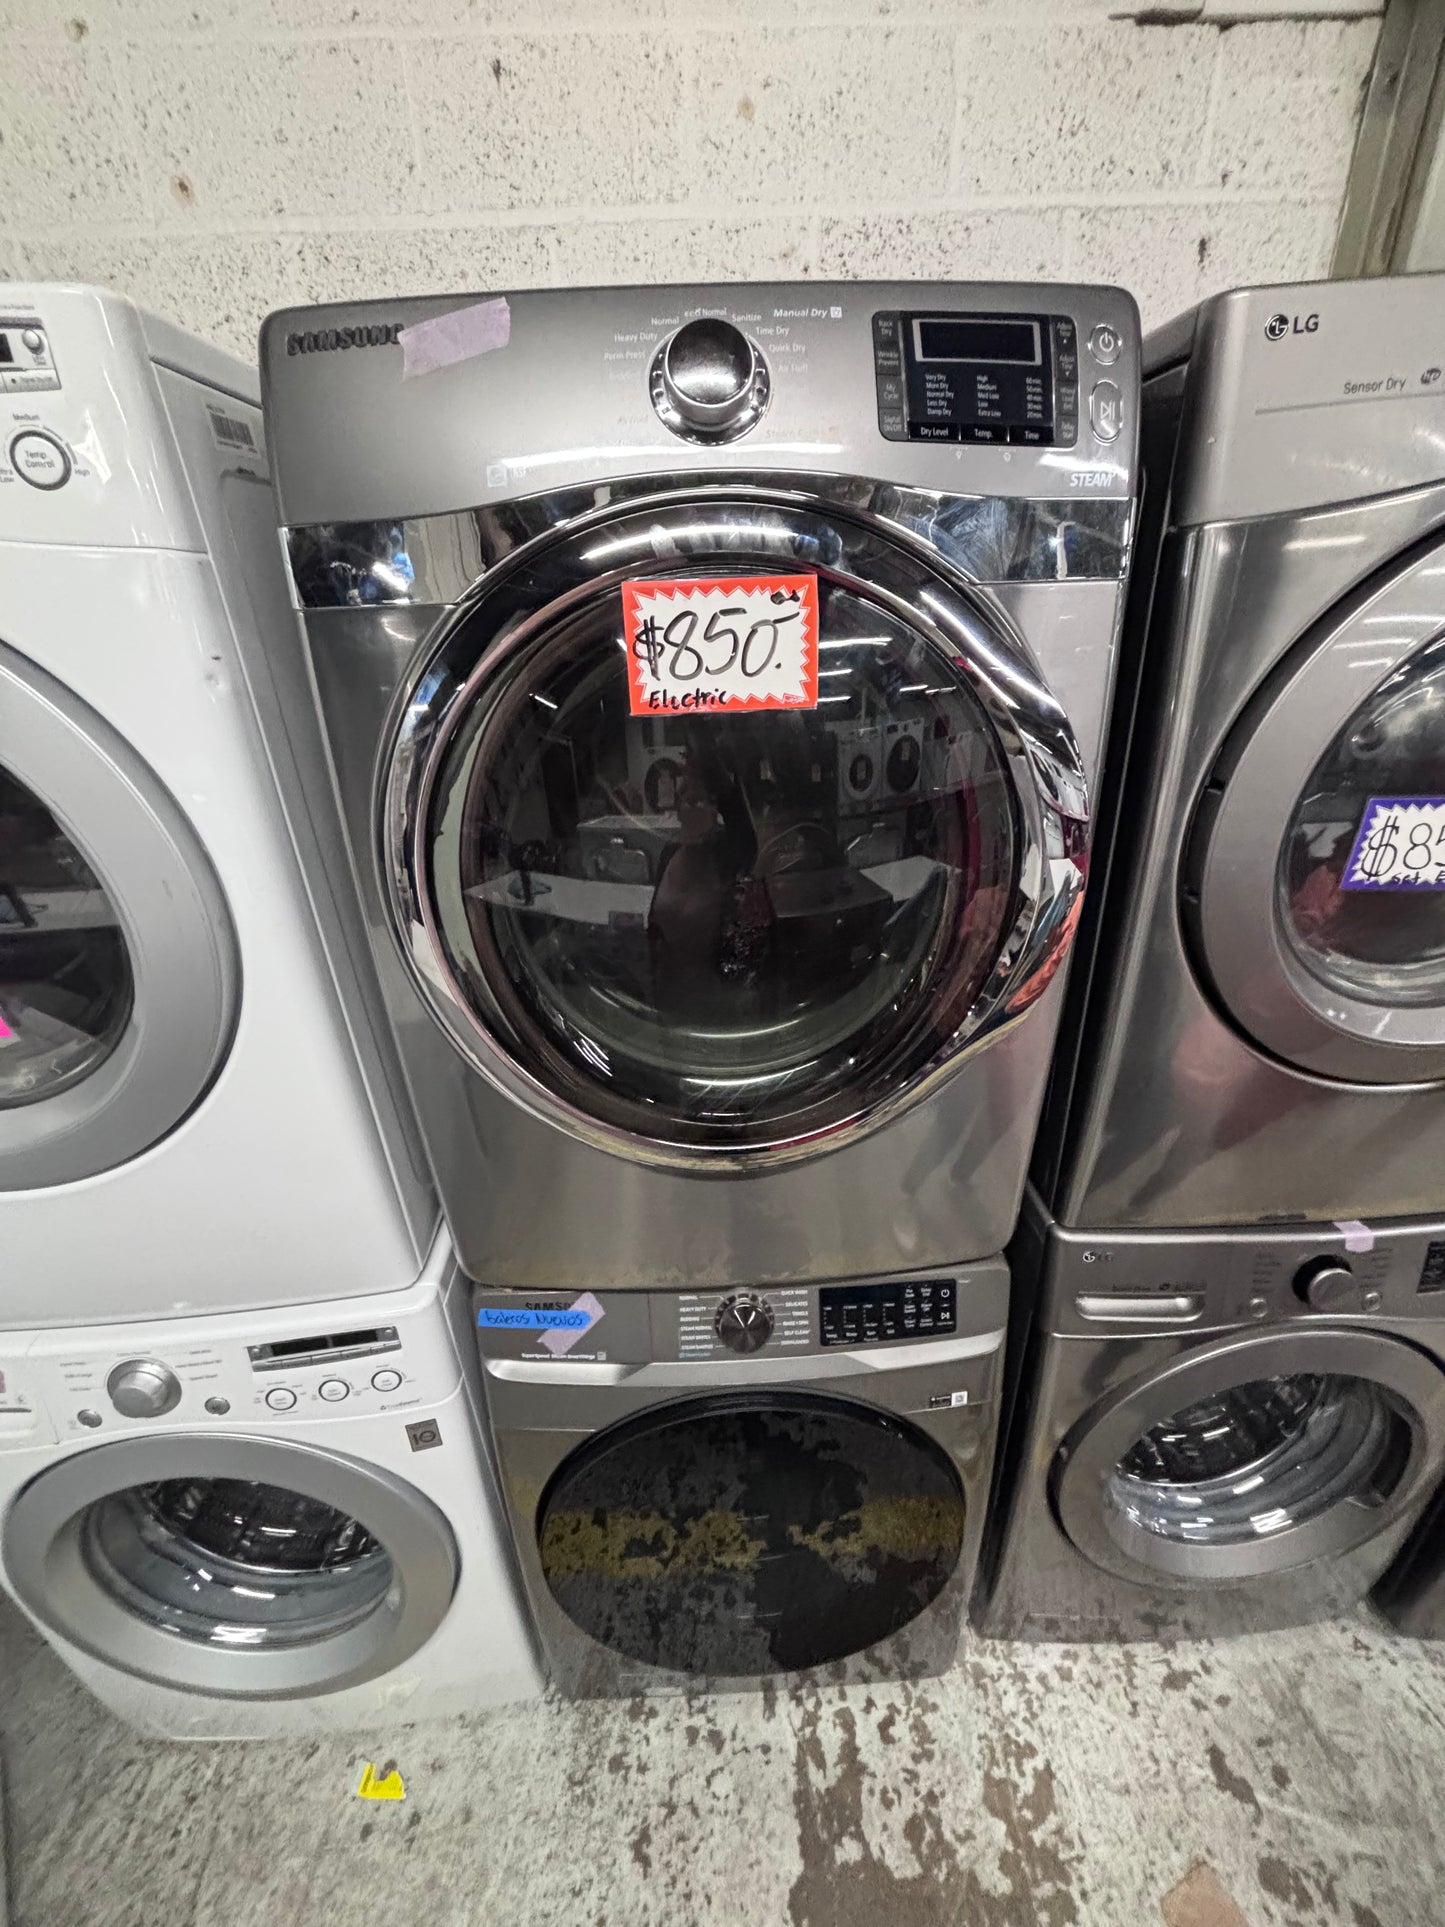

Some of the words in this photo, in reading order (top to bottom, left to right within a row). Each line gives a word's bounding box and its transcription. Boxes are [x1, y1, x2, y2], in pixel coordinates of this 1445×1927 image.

[732, 314, 762, 323] Sanitize
[773, 308, 808, 318] Manual
[810, 308, 828, 319] Dry
[651, 317, 680, 326] Normal
[1293, 314, 1320, 334] LG
[755, 326, 774, 336] Time
[776, 326, 790, 337] Dry
[614, 333, 638, 343] Heavy
[639, 332, 658, 342] Duty
[769, 343, 791, 353] Quick
[792, 343, 806, 353] Dry
[940, 382, 949, 390] Dry
[1343, 381, 1384, 394] Sensor
[1385, 377, 1407, 392] Dry
[945, 391, 955, 400] Dry
[939, 400, 948, 408] Dry
[943, 408, 952, 417] Dry
[920, 426, 932, 437] Dry
[932, 427, 949, 436] Level
[974, 428, 994, 439] Temp.
[1024, 430, 1040, 440] Time
[25, 450, 47, 460] Temp
[25, 459, 55, 469] Control
[74, 468, 91, 477] High
[1069, 472, 1113, 487] STEAM
